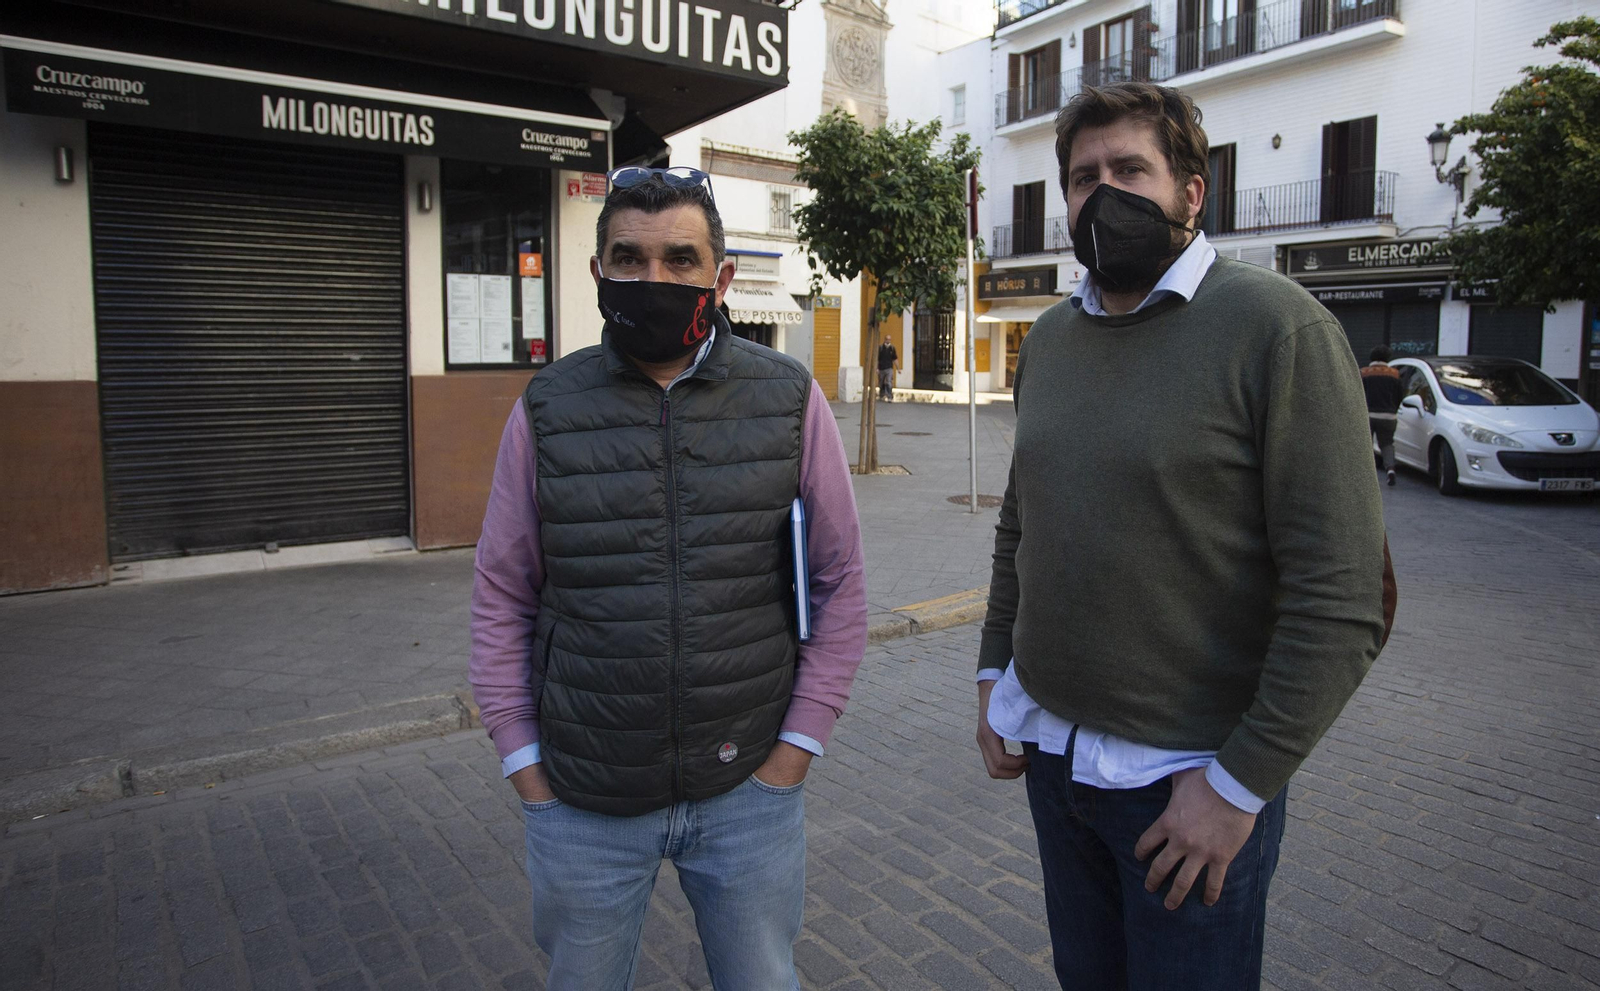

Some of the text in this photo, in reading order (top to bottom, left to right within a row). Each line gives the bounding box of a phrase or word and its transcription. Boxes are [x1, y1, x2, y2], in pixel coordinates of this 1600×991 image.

[402, 0, 783, 77] ONGUITAS
[36, 65, 145, 95] Cruzcampo
[33, 85, 150, 105] MAESTROS CERVECEROS
[82, 101, 105, 110] 1904
[262, 94, 435, 146] MILONGUITAS
[521, 128, 589, 150] Cruzcampo
[732, 287, 773, 296] Primitiva
[1319, 290, 1384, 300] BAR-RESTAURANTE
[731, 310, 802, 321] EL POSTIGO
